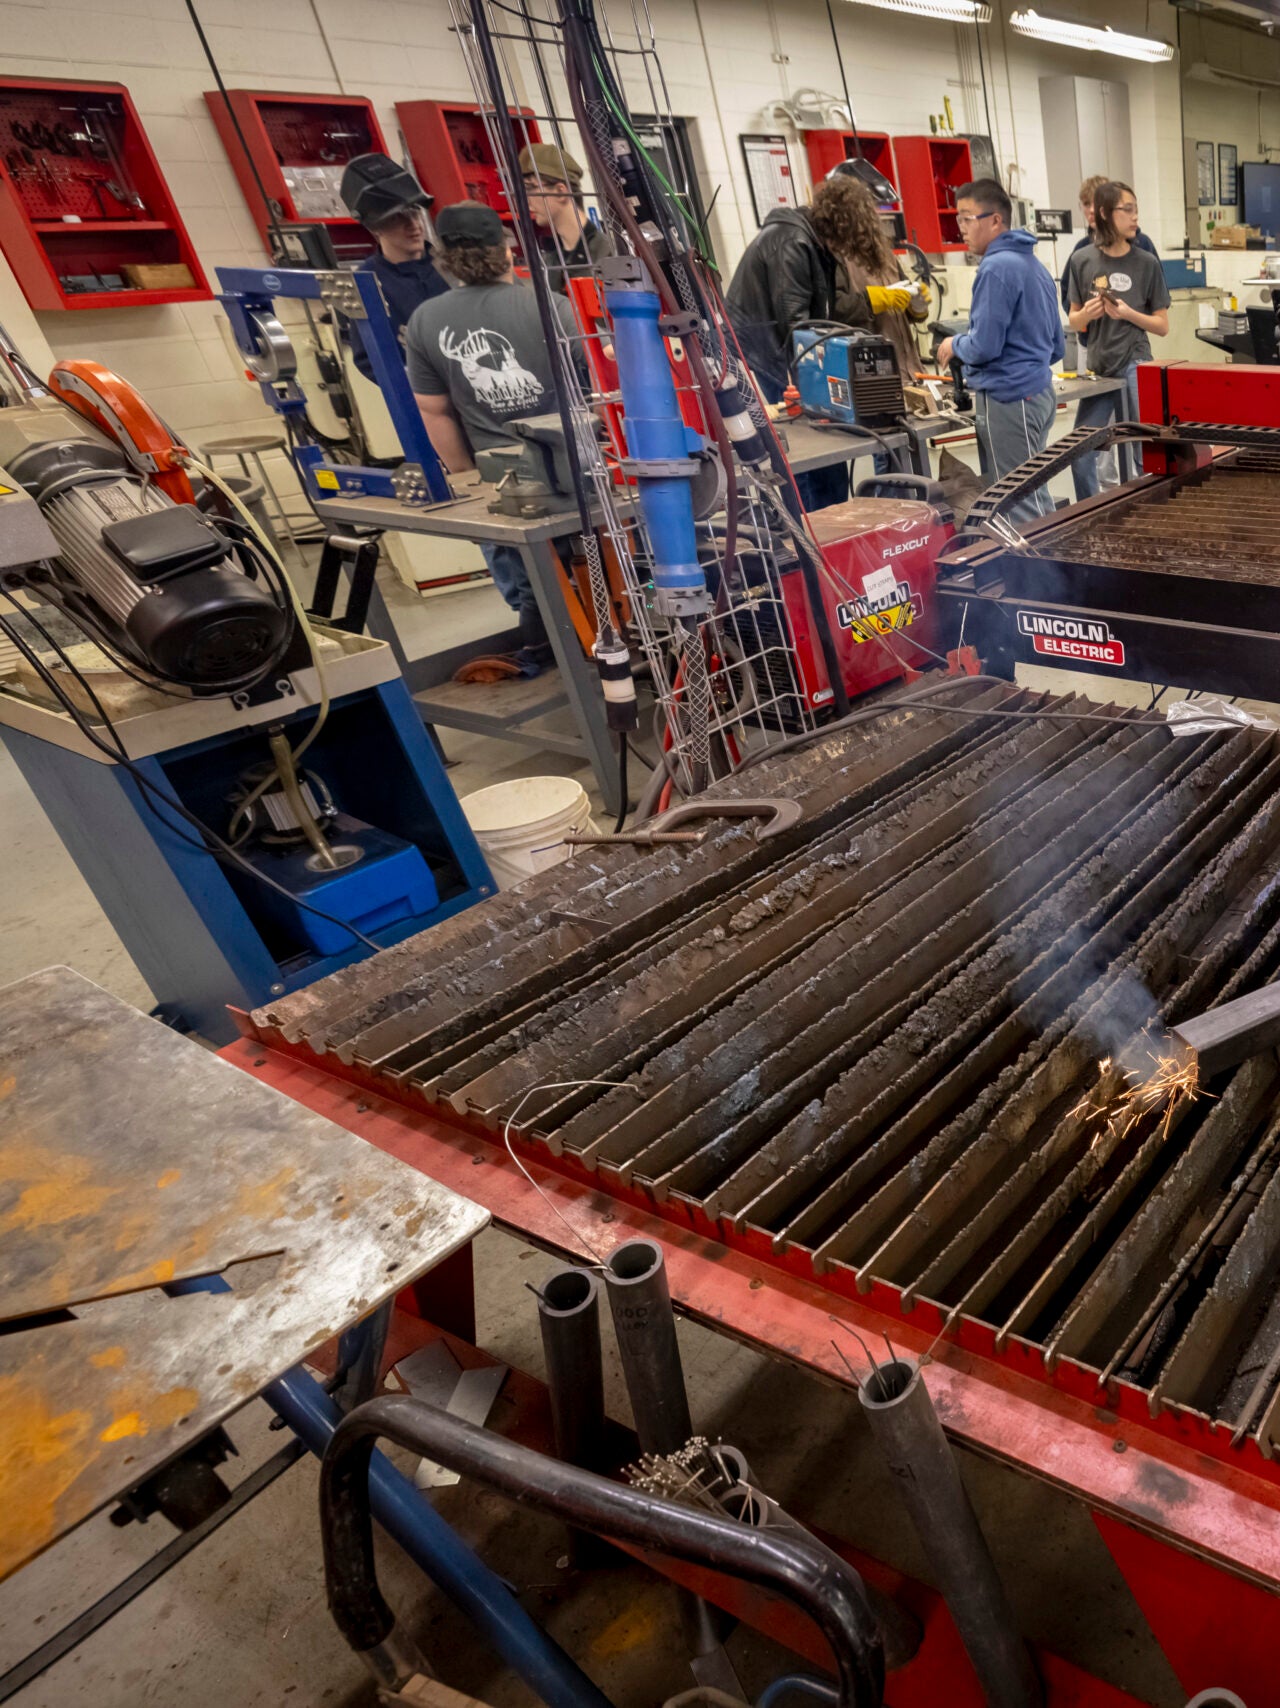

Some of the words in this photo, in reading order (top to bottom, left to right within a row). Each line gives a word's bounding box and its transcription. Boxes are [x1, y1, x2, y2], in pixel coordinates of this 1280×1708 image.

[882, 535, 930, 559] FLEXCUT
[1022, 615, 1104, 642] LINCOLN
[1043, 638, 1115, 660] ELECTRIC
